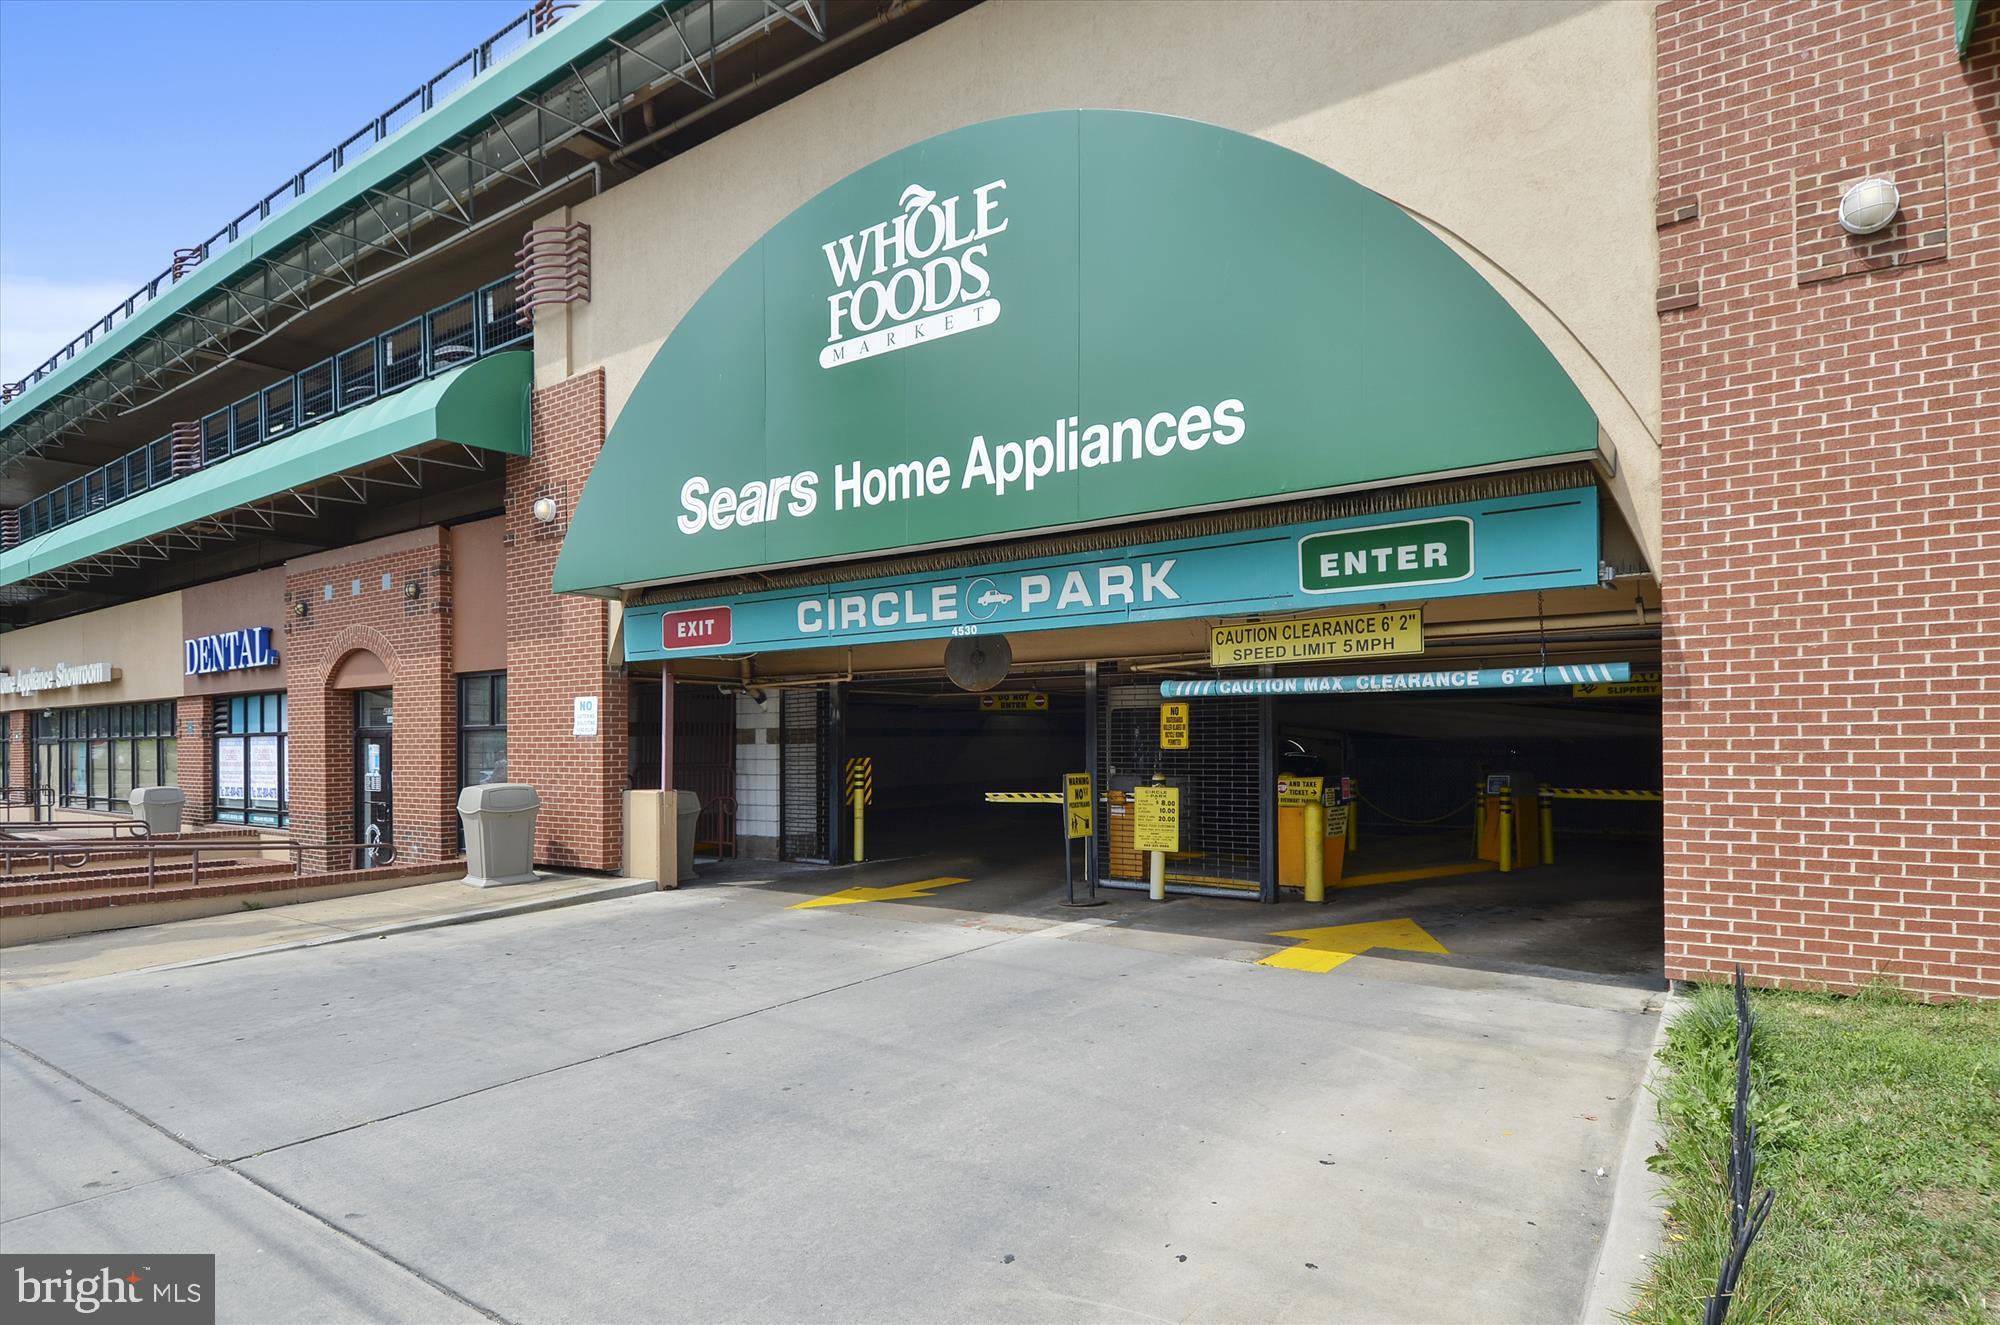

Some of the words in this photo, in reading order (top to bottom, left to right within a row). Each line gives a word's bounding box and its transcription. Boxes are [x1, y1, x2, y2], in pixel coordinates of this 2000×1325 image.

[822, 178, 1008, 287] WHOLE
[828, 243, 990, 342] FOODS
[833, 306, 984, 361] MARKET
[677, 470, 818, 535] Sears
[834, 456, 950, 511] Home
[961, 398, 1245, 495] Appliances
[1320, 542, 1448, 578] ENTER
[797, 585, 957, 632] CIRCLE
[1021, 559, 1180, 612] PARK
[677, 619, 715, 638] EXIT
[951, 625, 978, 636] 4530
[1215, 626, 1275, 645] CAUTION
[1282, 618, 1376, 640] CLEARANCE
[185, 626, 269, 676] DENTAL
[1233, 645, 1286, 661] SPEED
[1292, 641, 1337, 656] LIMIT
[16, 665, 54, 697] Appliance
[56, 662, 104, 688] Showroom
[1219, 678, 1297, 694] CAUTION
[1304, 677, 1344, 692] MAX
[1355, 671, 1480, 690] CLEARANCE
[1607, 686, 1657, 694] SLIPPERY
[580, 701, 592, 711] NO
[1170, 706, 1179, 716] NO
[1069, 777, 1089, 785] WARNING
[1075, 788, 1083, 800] NO
